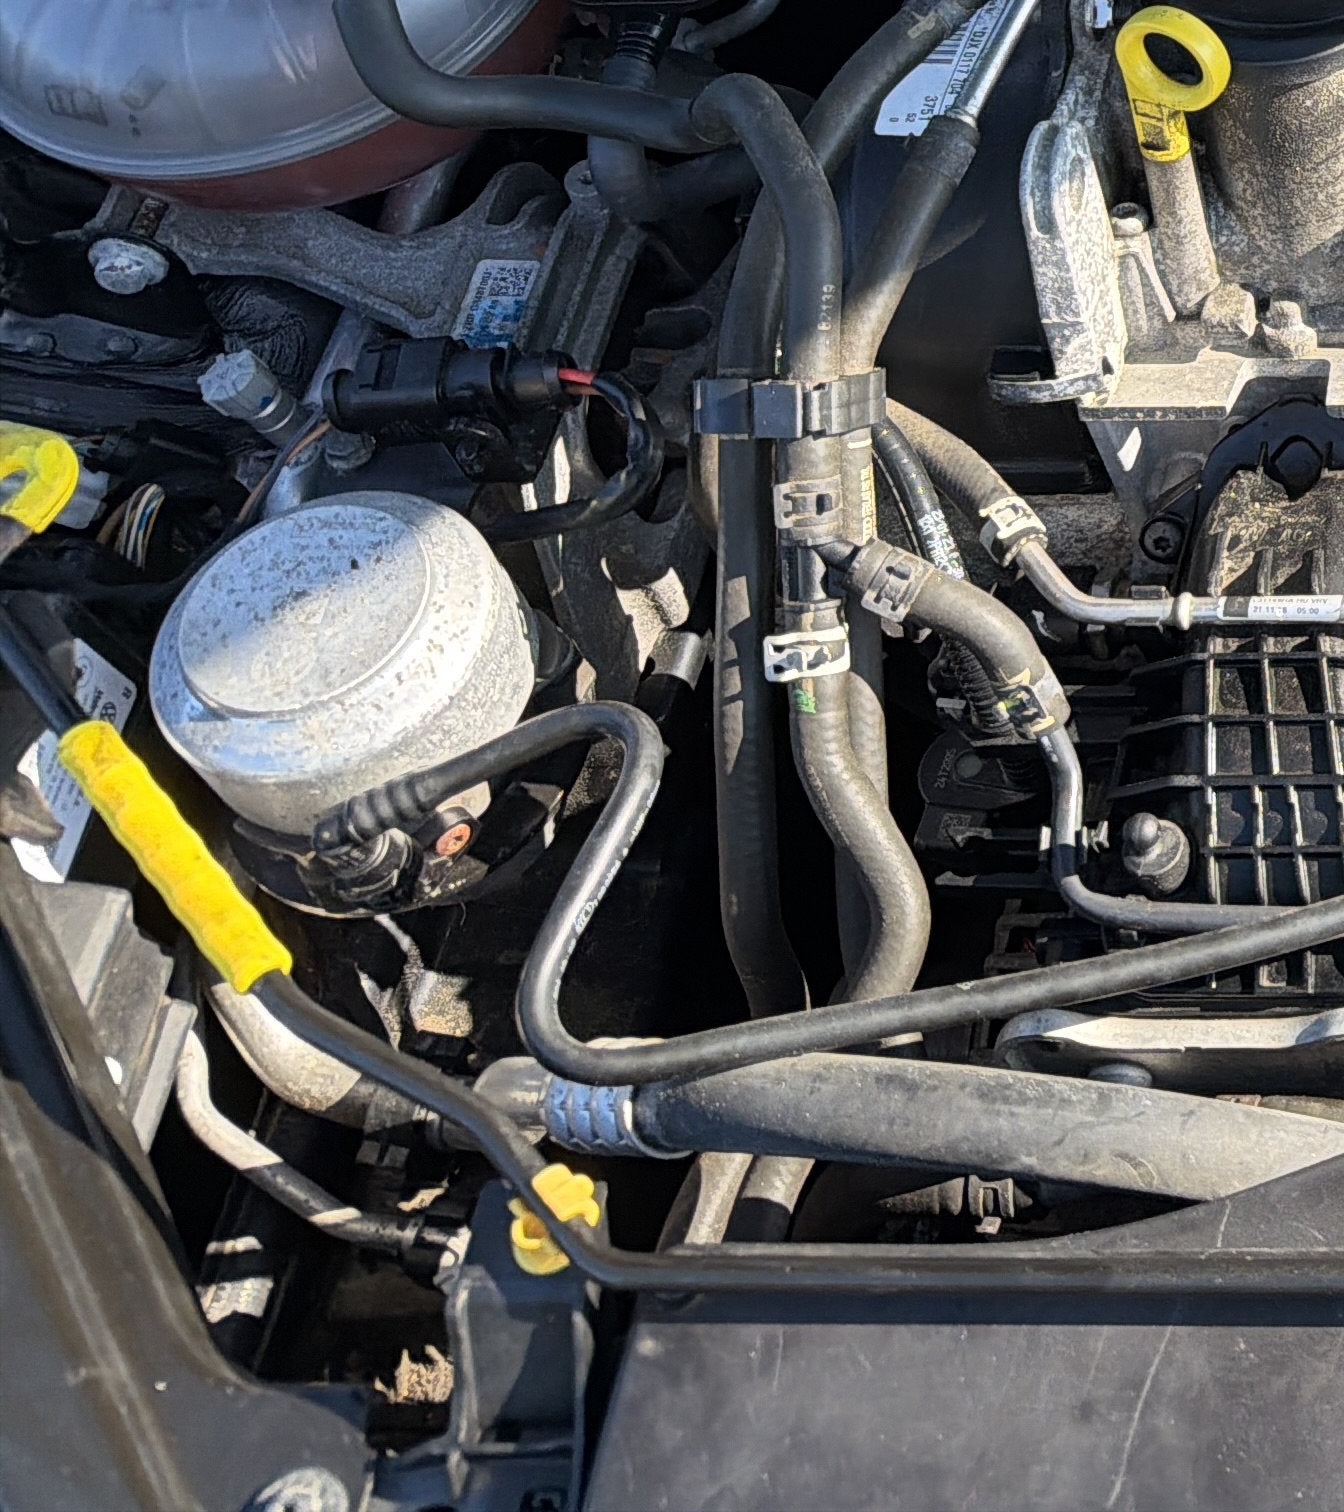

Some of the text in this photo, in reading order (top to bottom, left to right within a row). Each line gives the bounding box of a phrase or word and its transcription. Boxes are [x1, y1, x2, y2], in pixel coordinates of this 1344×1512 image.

[957, 52, 976, 73] 0117
[905, 112, 917, 123] 52
[919, 96, 938, 120] 3751
